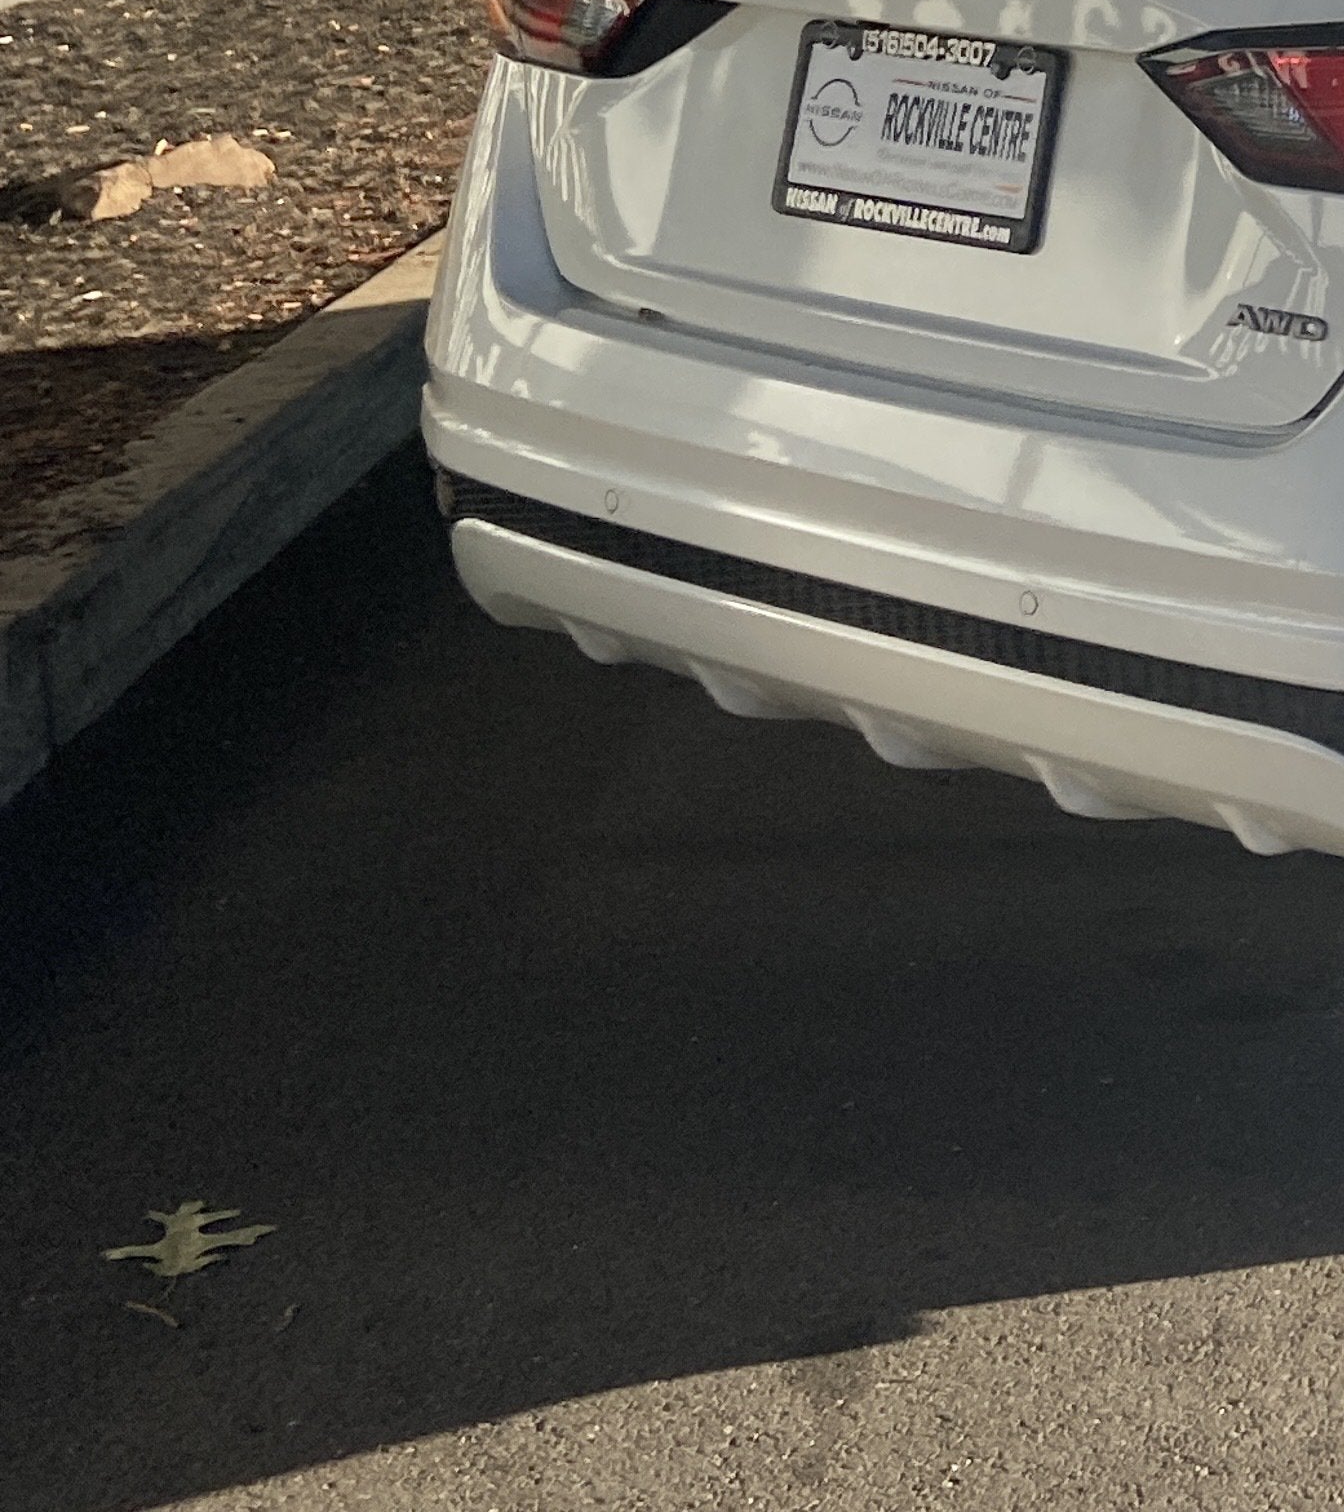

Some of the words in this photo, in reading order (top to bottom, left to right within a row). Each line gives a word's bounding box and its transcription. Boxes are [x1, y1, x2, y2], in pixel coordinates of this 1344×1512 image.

[805, 102, 863, 122] NISSAN
[880, 92, 972, 152] ROCKVILLE
[969, 104, 1034, 162] CENTRE
[785, 187, 839, 216] NISSAN
[1227, 304, 1329, 342] AWD
